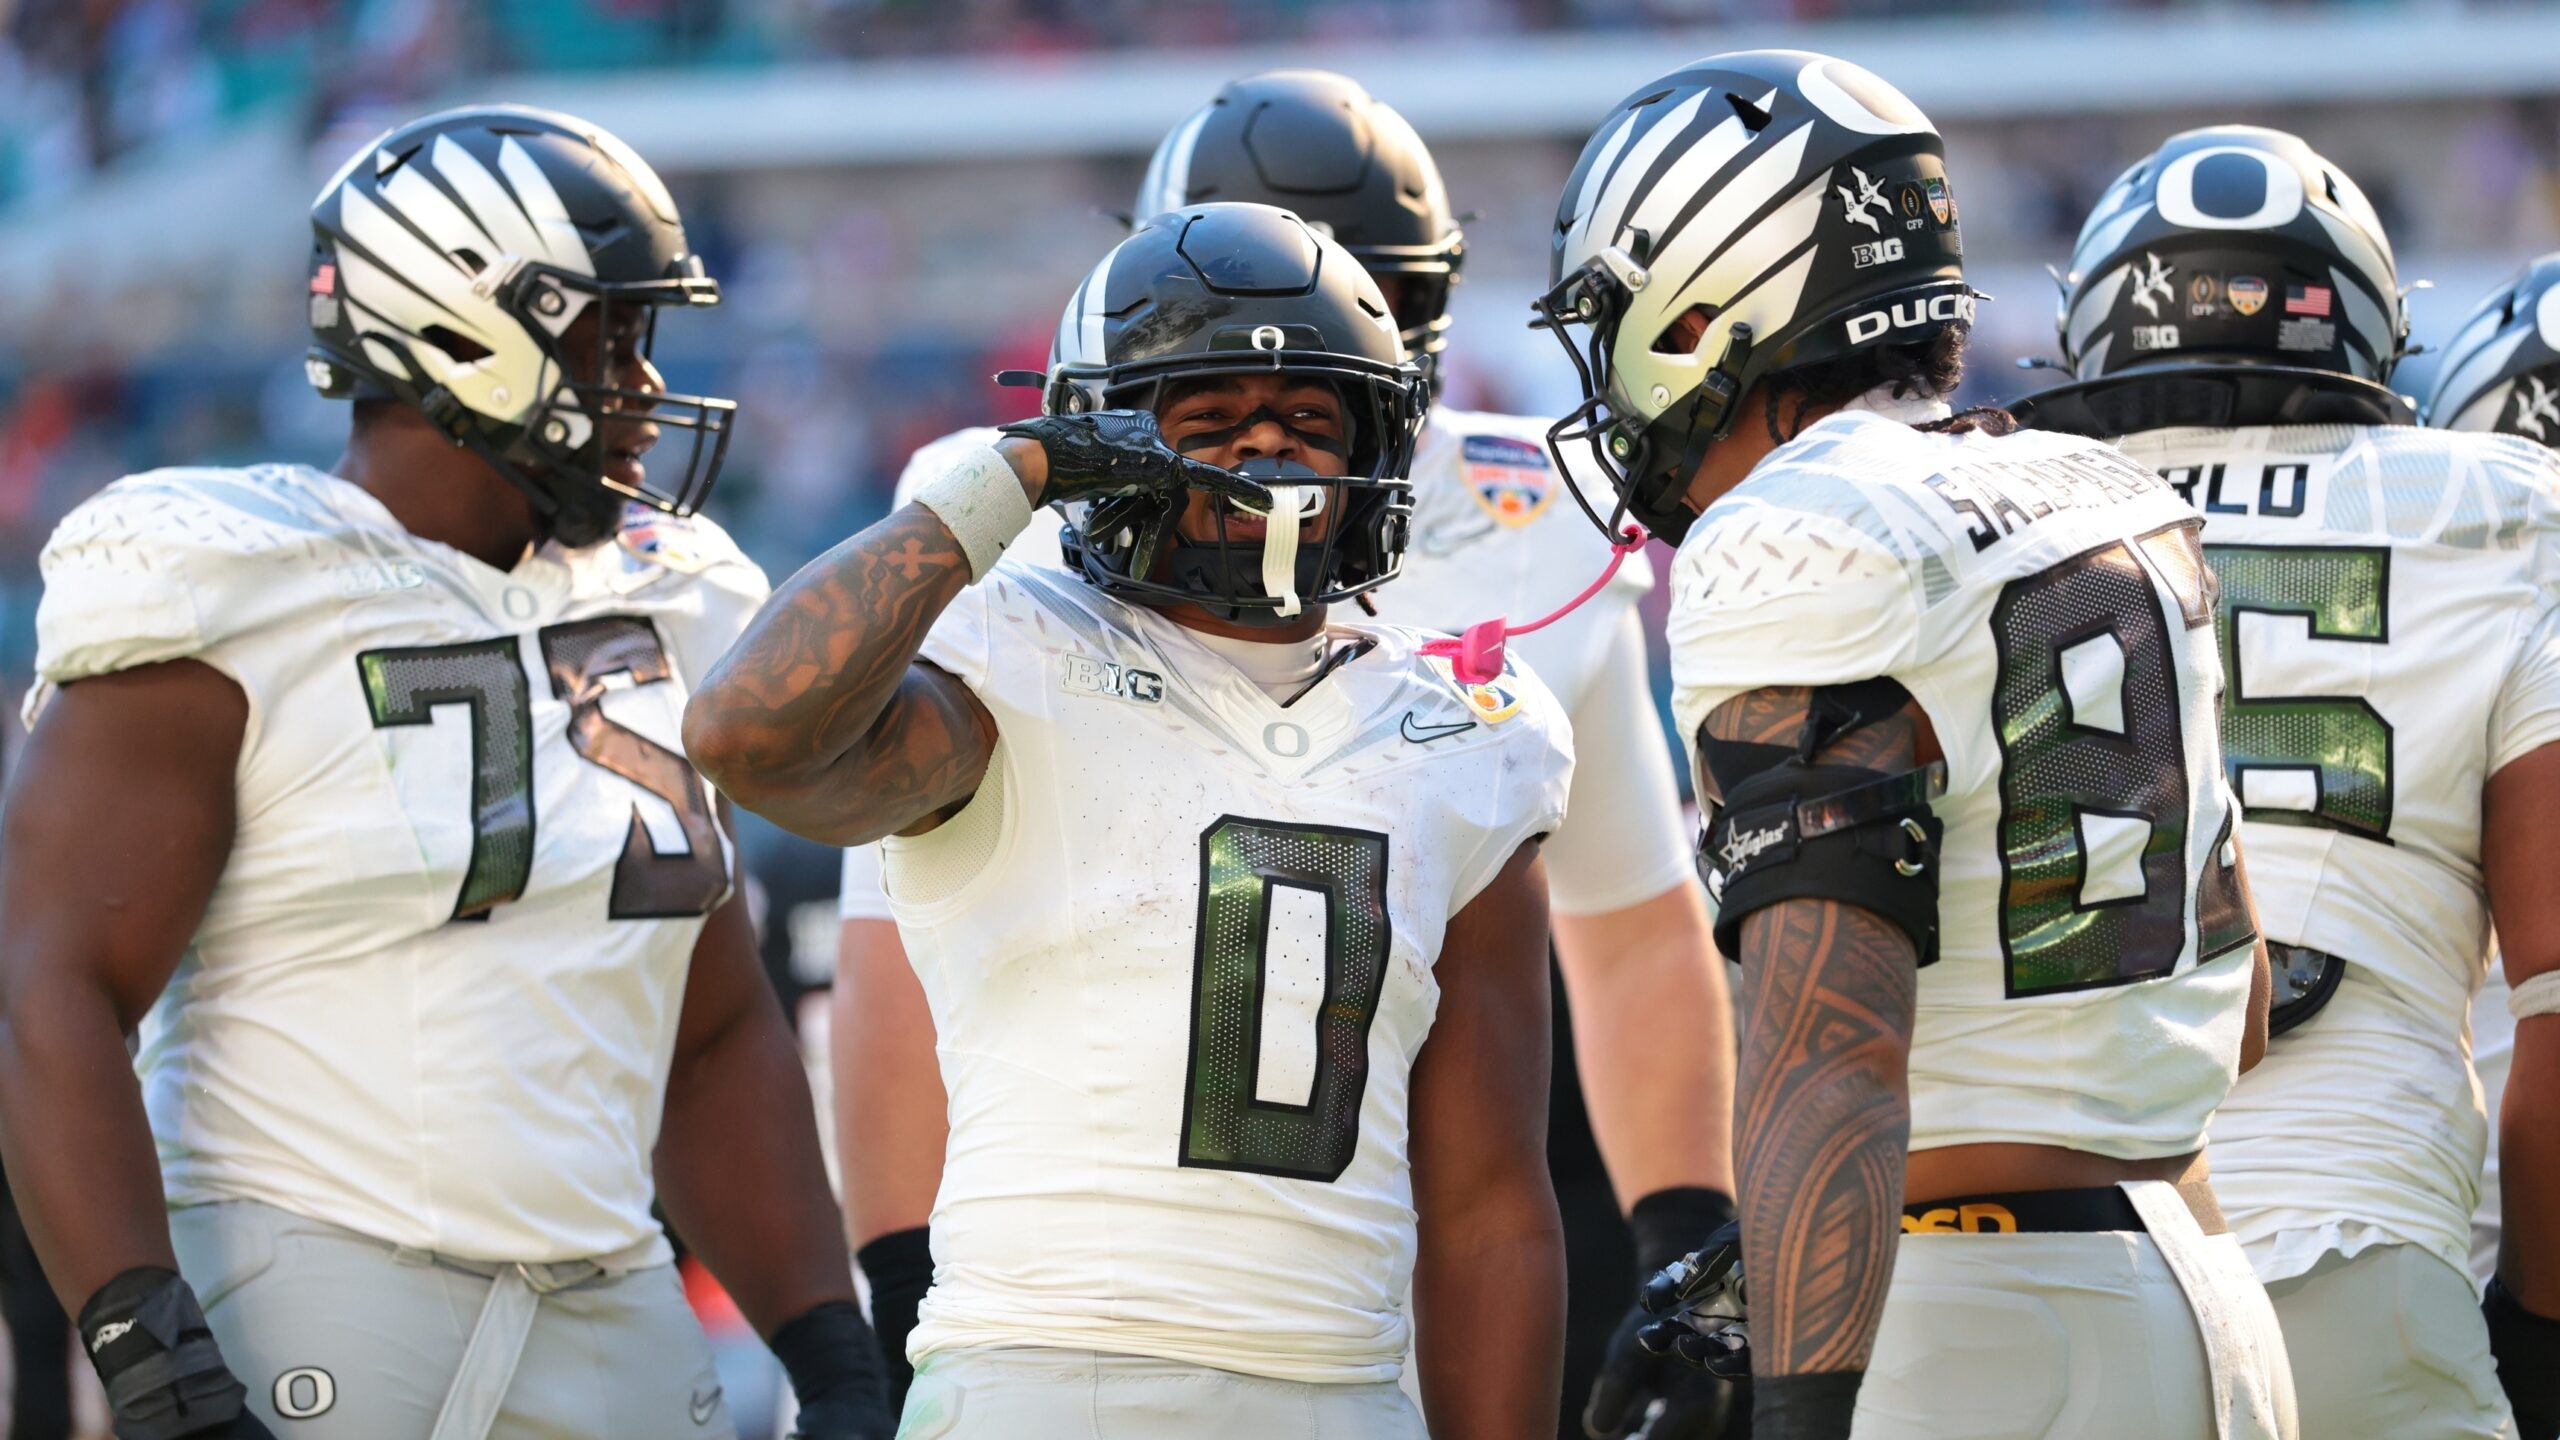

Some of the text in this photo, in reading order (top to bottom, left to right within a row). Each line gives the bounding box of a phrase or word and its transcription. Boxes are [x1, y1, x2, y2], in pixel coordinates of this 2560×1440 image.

[1797, 60, 1940, 135] O
[2156, 146, 2303, 230] O
[1906, 218, 1924, 231] CFP
[1251, 326, 1285, 350] O
[2157, 463, 2309, 518] RLD
[502, 585, 539, 621] O
[2202, 543, 2395, 847] 6
[1262, 721, 1310, 758] O
[272, 1366, 336, 1420] O
